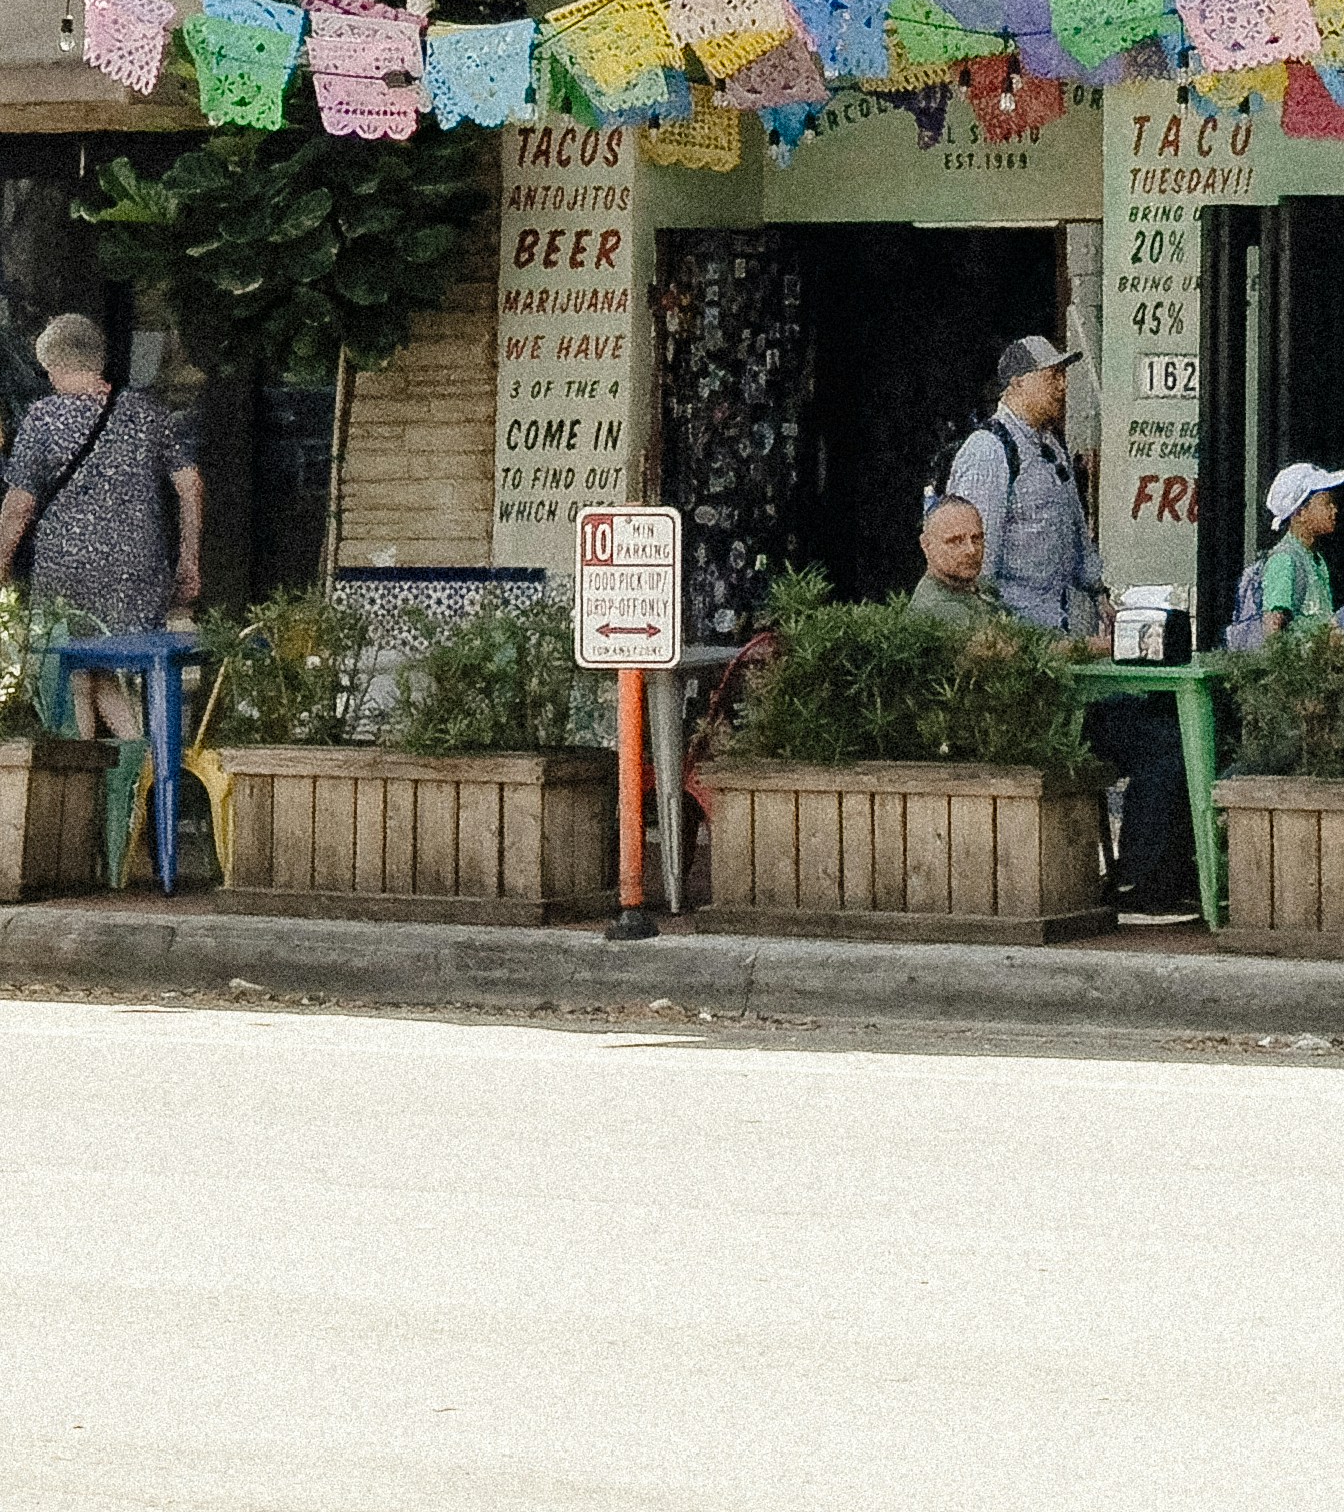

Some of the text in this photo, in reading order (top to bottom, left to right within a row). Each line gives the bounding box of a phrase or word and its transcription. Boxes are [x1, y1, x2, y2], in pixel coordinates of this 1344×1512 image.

[517, 126, 623, 168] TACOS
[1133, 114, 1252, 157] TACO
[1129, 167, 1254, 195] TUESDAY!!
[507, 185, 630, 212] ANTOJITOS
[1128, 205, 1185, 223] BRING
[512, 228, 622, 270] BEER
[1131, 229, 1185, 265] 20%
[1118, 275, 1173, 293] BRING
[502, 288, 630, 314] MARIJUANA
[1132, 301, 1184, 336] 45%
[506, 334, 625, 360] WE HAVE
[510, 380, 619, 399] 3 OF THE 4
[506, 419, 623, 451] COME IN
[1129, 420, 1176, 438] BRING
[1129, 440, 1154, 458] THE
[502, 466, 622, 490] TO FIND OUT
[499, 499, 558, 523] WHICH
[583, 522, 655, 562] 10 MIN
[616, 543, 670, 559] PARKING
[588, 572, 616, 591] FOOD
[640, 597, 669, 617] ONLY
